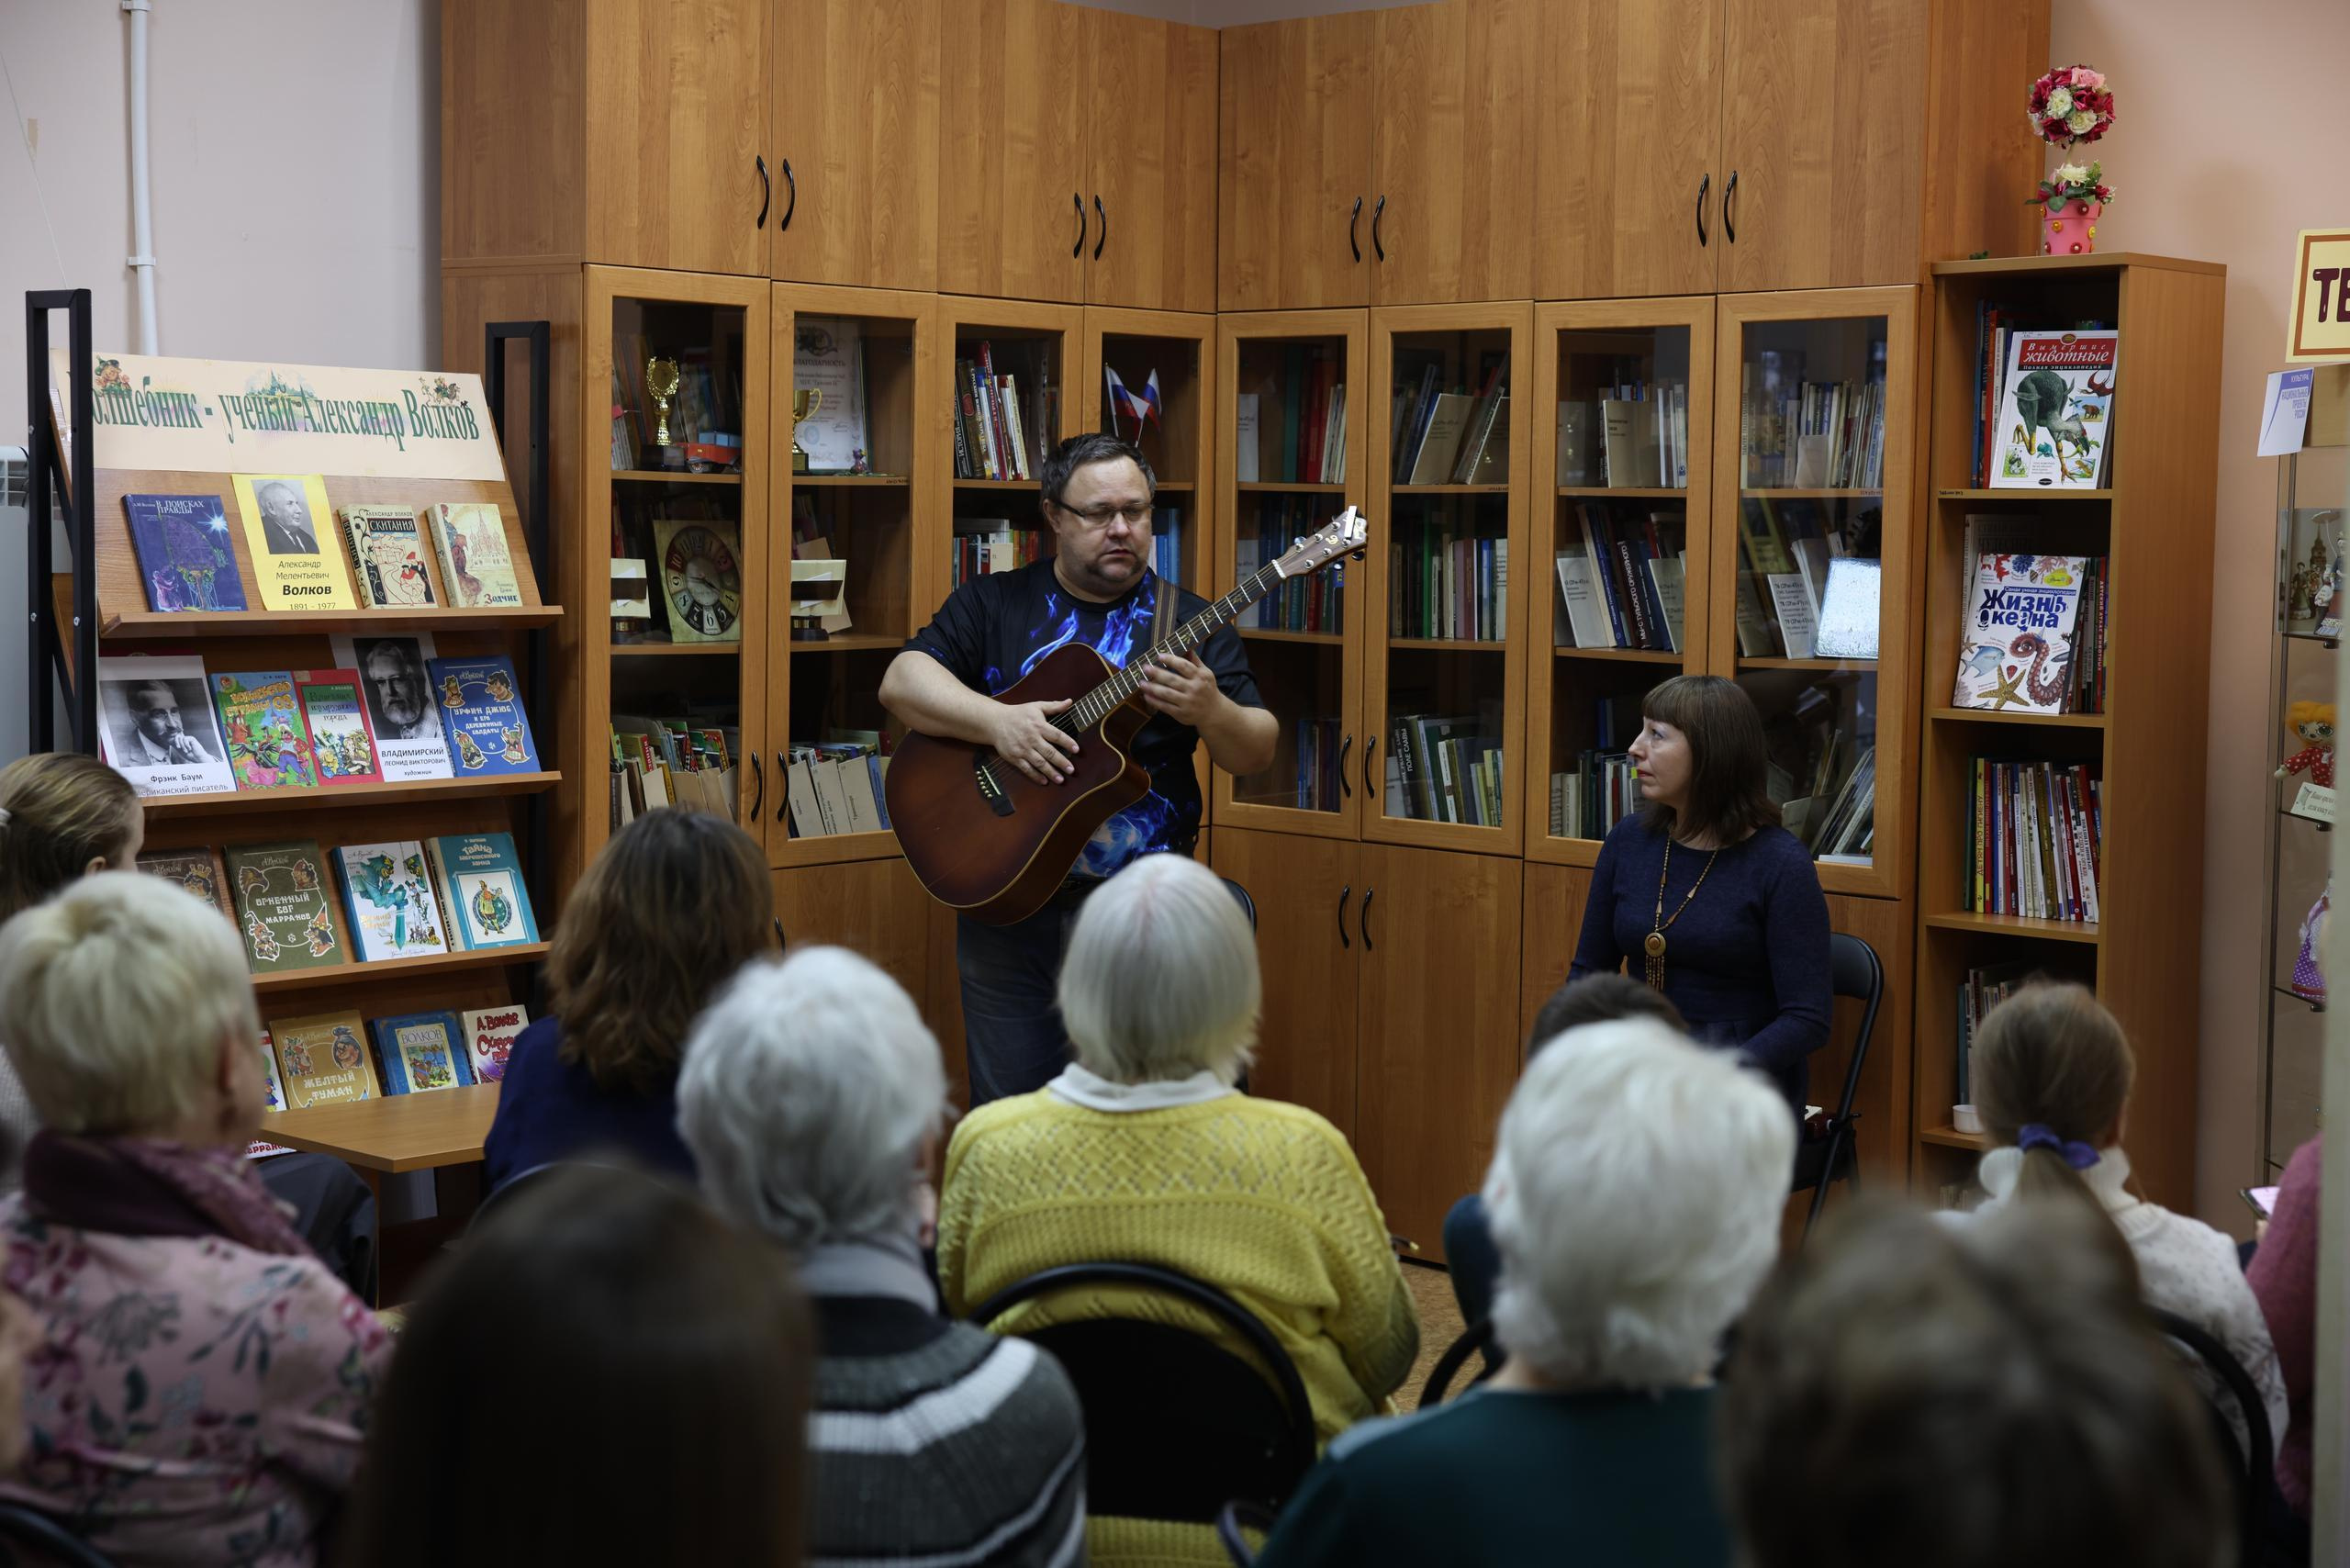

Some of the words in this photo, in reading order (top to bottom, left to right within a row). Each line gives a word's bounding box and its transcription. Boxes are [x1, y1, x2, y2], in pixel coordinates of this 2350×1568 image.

[794, 359, 846, 367] ЛАГОДАРНОСТЬ
[92, 375, 203, 428] олшебник
[299, 385, 405, 452] Александр
[401, 389, 479, 441] Волков
[157, 506, 193, 515] ПРАВДЫ
[369, 520, 415, 532] СКИТАНИЯ
[278, 560, 321, 568] Александр
[275, 572, 330, 580] Мелентьевич
[283, 585, 331, 595] Волков
[1980, 588, 2067, 613] Жизнь
[706, 611, 714, 627] 6
[486, 706, 511, 715] ДЖЮС
[381, 747, 444, 757] ВЛАДИМИРСКИЙ
[151, 776, 178, 784] Фрэнк
[181, 773, 203, 781] Баум
[137, 785, 190, 796] ериканский
[192, 784, 229, 792] писатель
[255, 891, 310, 906] ОГНЕННЫЙ
[276, 905, 294, 913] БОГ
[265, 913, 311, 924] МАРРАНОВ
[401, 1029, 443, 1044] ВОЛКОВ
[303, 1070, 355, 1089] ЖЕЛТЫЙ
[311, 1086, 353, 1101] ТУМАН
